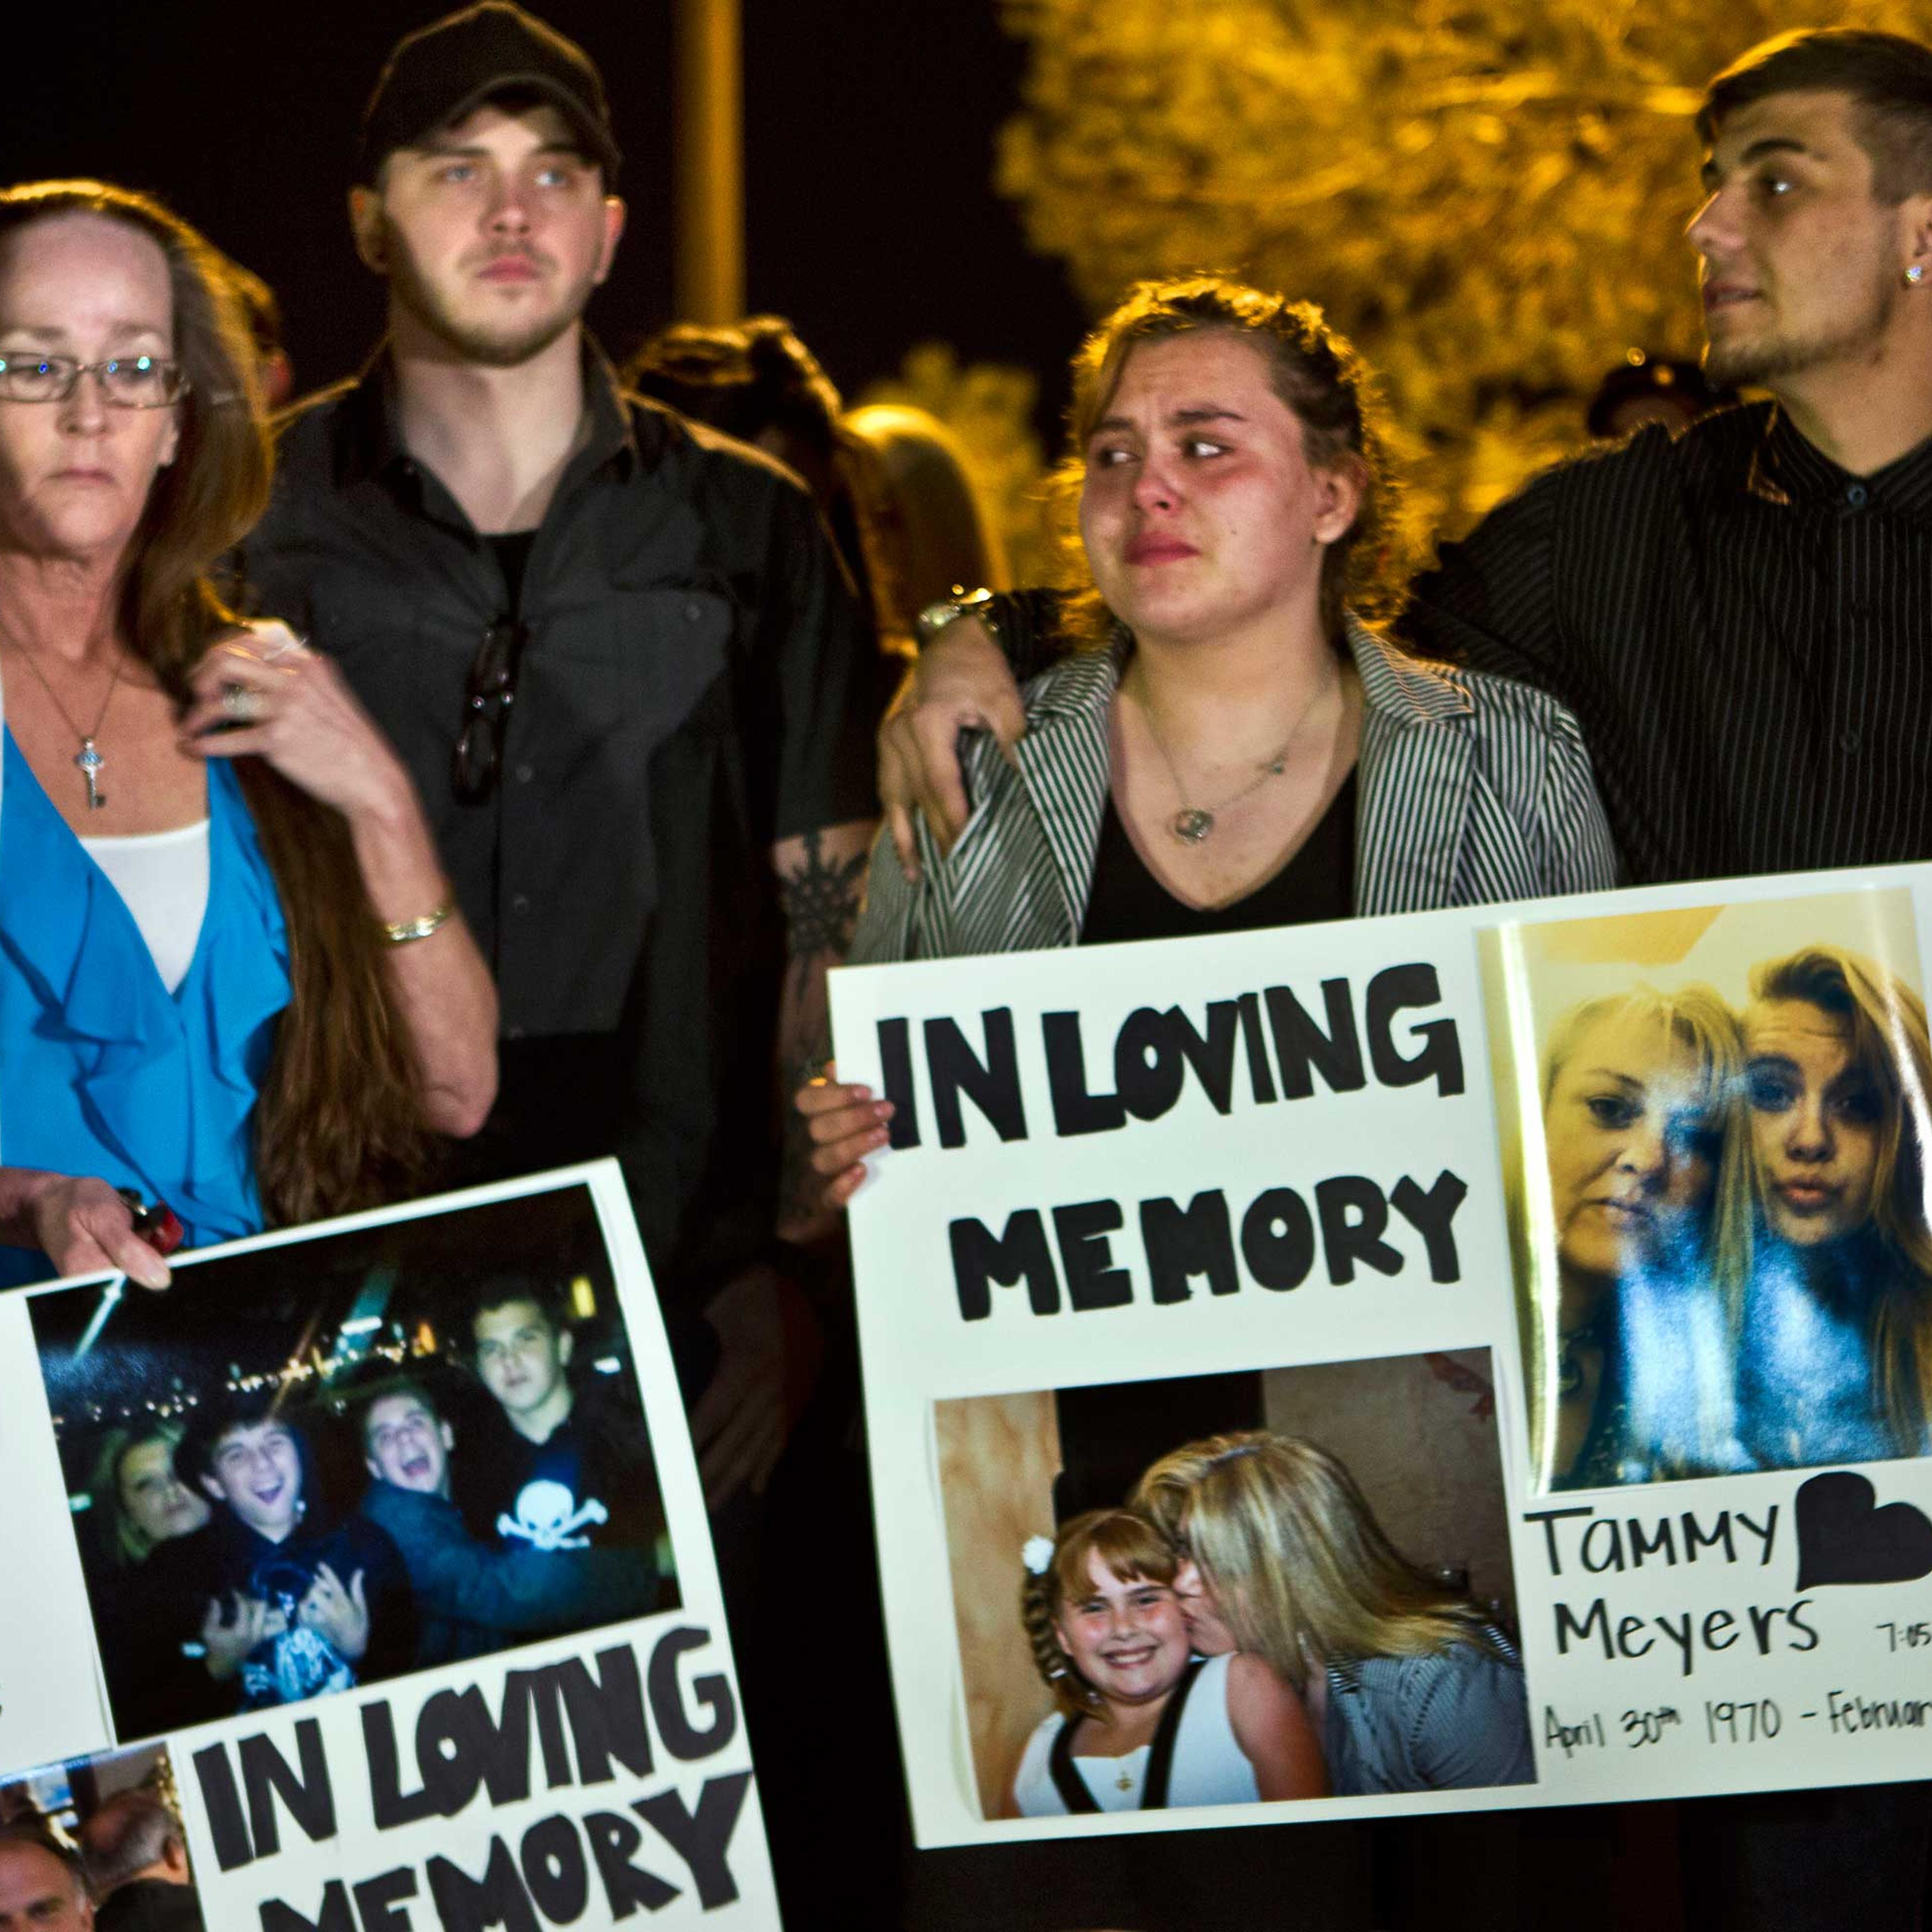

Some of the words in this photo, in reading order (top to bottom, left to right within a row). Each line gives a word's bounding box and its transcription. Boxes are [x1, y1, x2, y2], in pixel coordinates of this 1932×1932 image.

[877, 1007, 1028, 1150] IN
[1041, 962, 1465, 1137] LOVING
[949, 1169, 1468, 1321] MEMORY
[1553, 1598, 1819, 1676] Meyers
[192, 1718, 338, 1872] IN
[360, 1627, 737, 1831] LOVING
[1545, 1705, 1605, 1758] April
[1705, 1698, 1781, 1744] 1970
